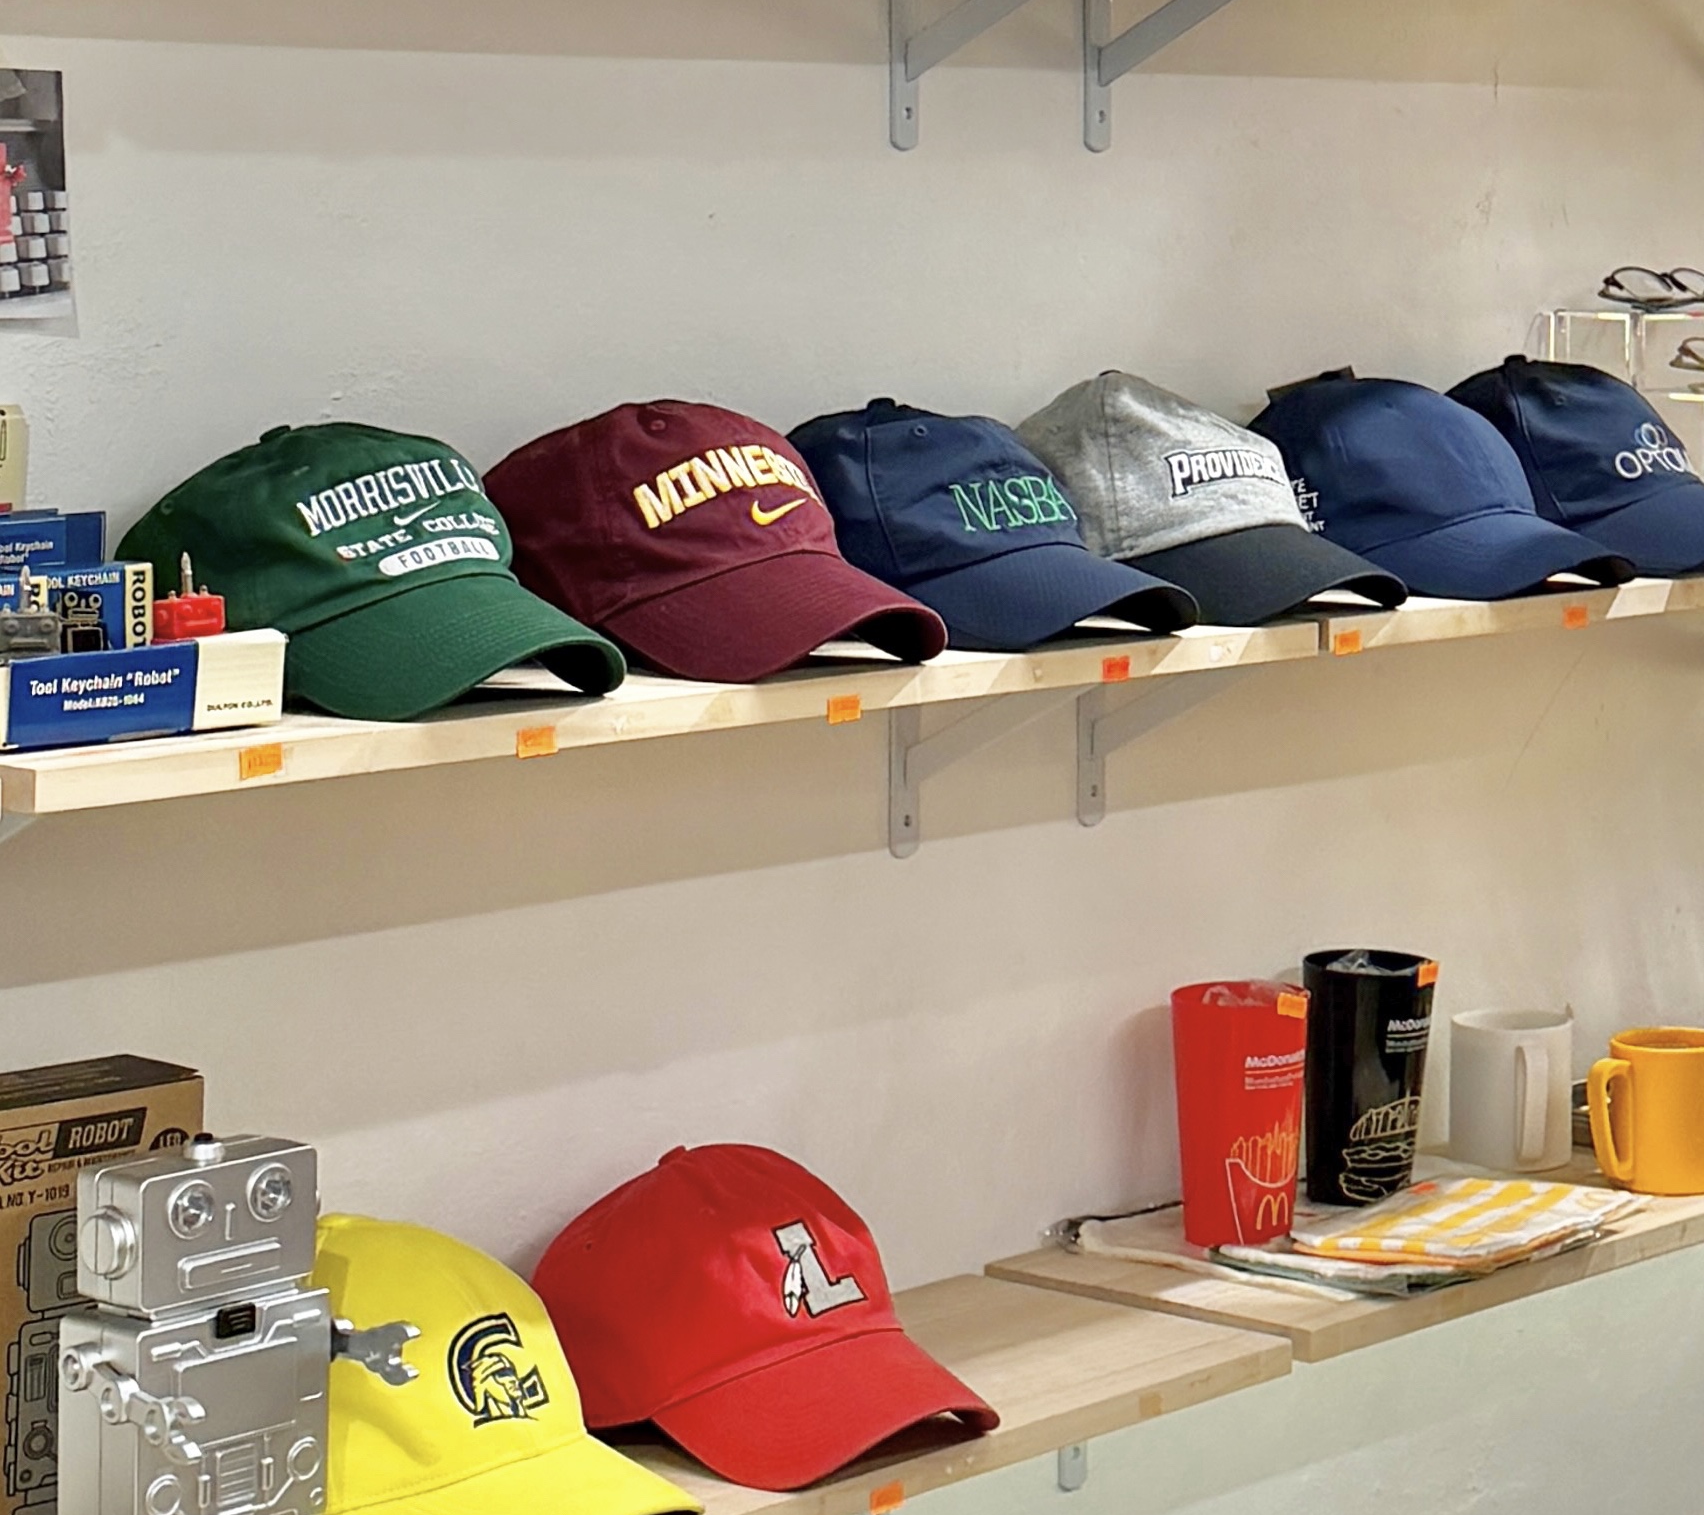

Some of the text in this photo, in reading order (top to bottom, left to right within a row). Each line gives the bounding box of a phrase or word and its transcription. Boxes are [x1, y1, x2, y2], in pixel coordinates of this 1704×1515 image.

[950, 475, 1077, 533] NASBA
[336, 529, 413, 561] STATE
[398, 539, 490, 569] FOOTBALL
[30, 679, 57, 696] Tool
[61, 674, 123, 695] Keychain
[68, 1117, 135, 1150] ROBOT
